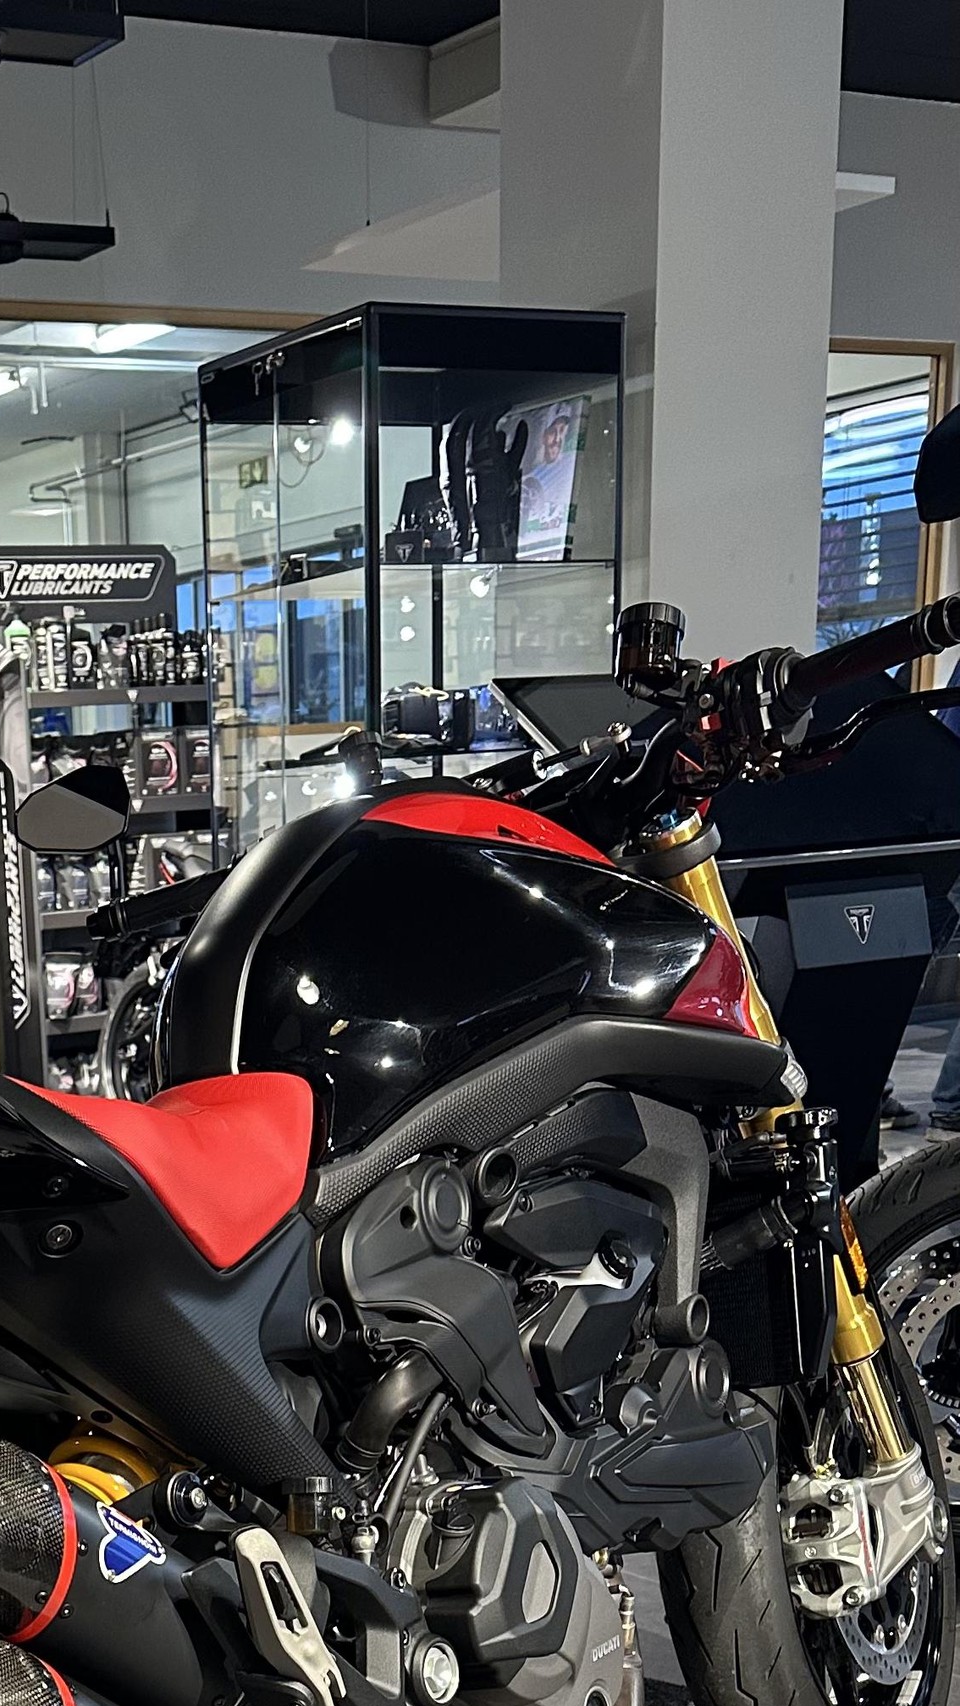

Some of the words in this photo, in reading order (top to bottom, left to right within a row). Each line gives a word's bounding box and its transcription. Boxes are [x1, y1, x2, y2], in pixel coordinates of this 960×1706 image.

[16, 562, 155, 580] PERFORMANCE
[10, 580, 114, 596] LUBRICANTS
[592, 1634, 620, 1662] DUCATI
